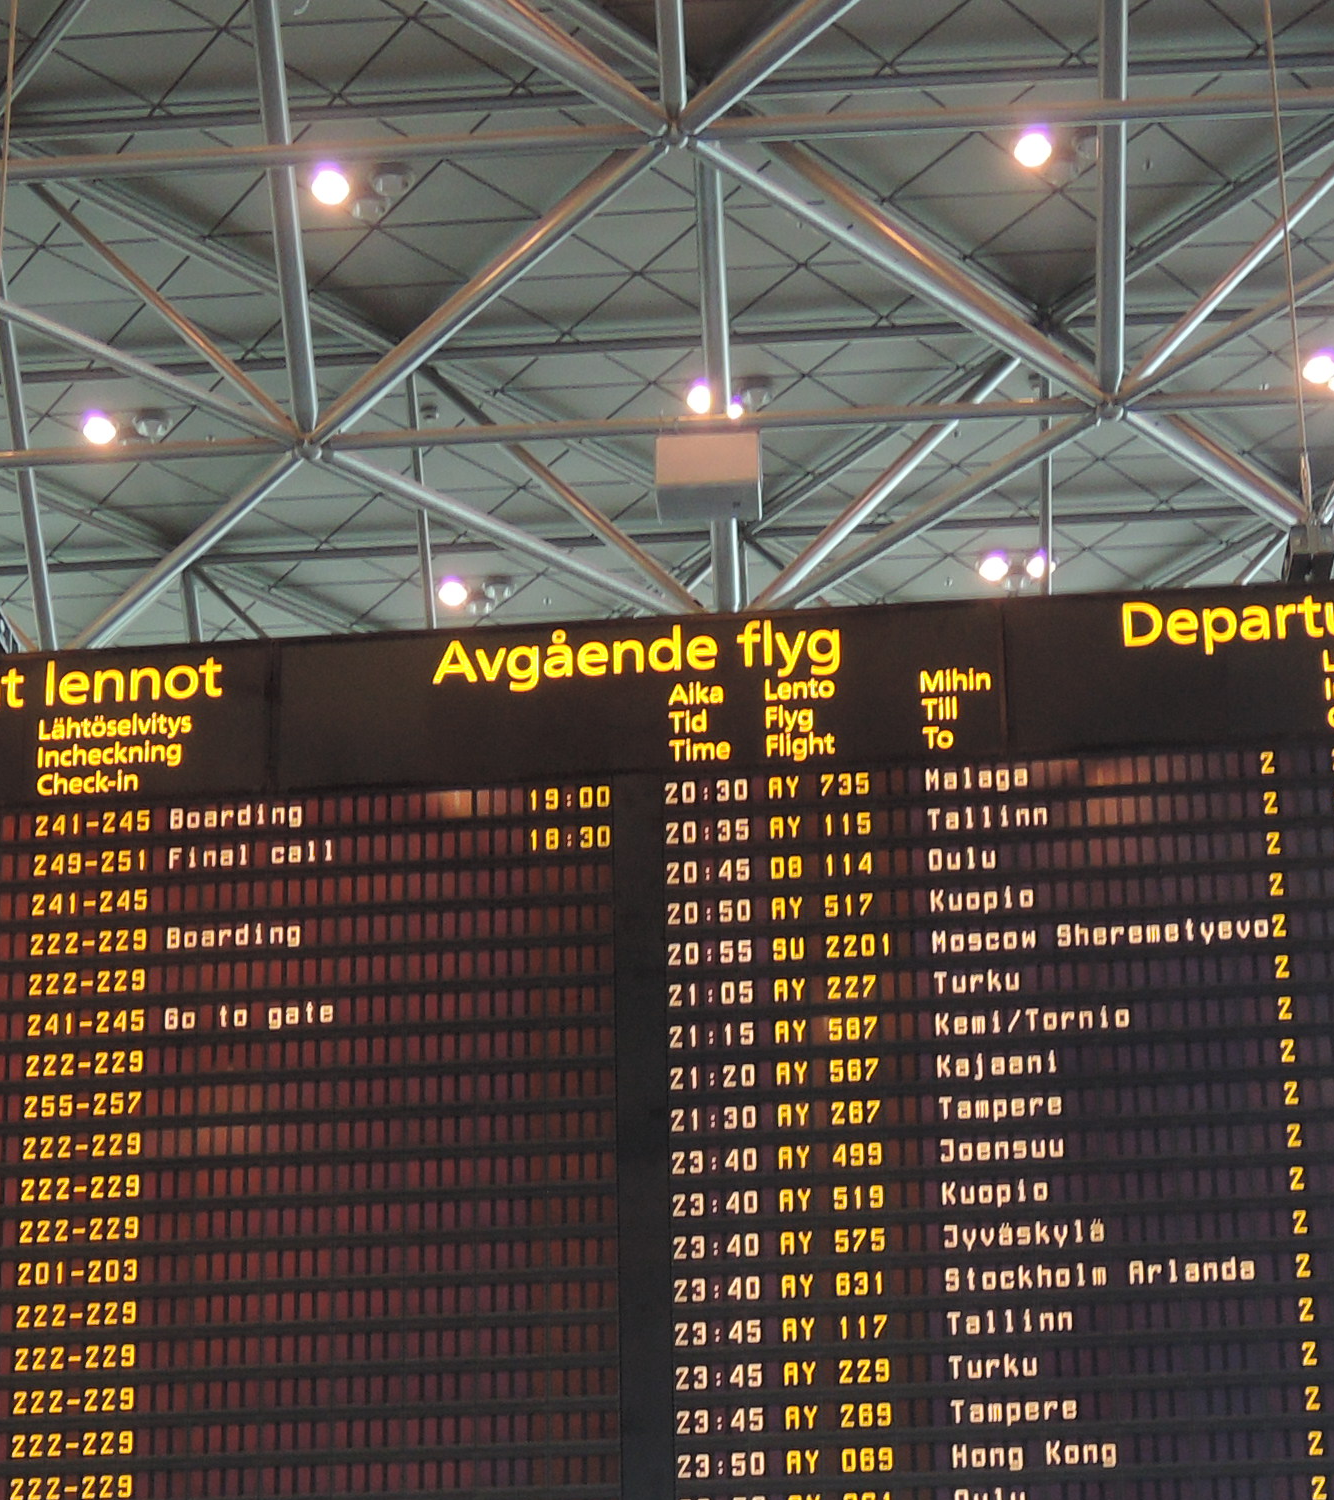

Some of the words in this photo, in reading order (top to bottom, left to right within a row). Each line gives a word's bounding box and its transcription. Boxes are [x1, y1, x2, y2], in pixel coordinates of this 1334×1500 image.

[432, 624, 719, 693] Avgående
[737, 620, 840, 677] flyg
[46, 658, 222, 705] lennot
[669, 681, 723, 705] Aika
[765, 678, 835, 700] Lento
[920, 668, 991, 692] Mihin
[669, 709, 707, 733] Tid
[766, 705, 813, 733] Flyg
[922, 696, 957, 720] Till
[39, 712, 191, 740] Lähtöselvitys
[923, 727, 953, 749] To
[38, 740, 181, 768] Incheckning
[669, 738, 730, 761] Time
[766, 732, 835, 761] Flight
[37, 770, 138, 795] Check-in
[926, 767, 1027, 791] Malaga
[170, 804, 302, 829] Boarding
[928, 805, 1047, 830] Tallinn
[169, 844, 246, 869] Final
[272, 840, 332, 863] call
[929, 847, 995, 871] Oulu
[930, 886, 1033, 913] Kuopio
[167, 923, 300, 949] Boarding
[932, 931, 1035, 953] Moscow
[1057, 919, 1268, 946] Sheremetyevo
[934, 969, 1019, 994] Turku
[165, 1008, 195, 1029] Go
[220, 1006, 247, 1027] to
[269, 1002, 333, 1029] gate
[935, 1006, 1129, 1036] Kemi/Tornio
[937, 1050, 1056, 1080] Kajaani
[939, 1097, 1061, 1122] Tampere
[940, 1139, 1063, 1162] Joensuu
[942, 1179, 1047, 1207] Kuopio
[944, 1219, 1104, 1251] Jyväskylä
[945, 1263, 1106, 1291] Stockholm
[1129, 1257, 1254, 1284] Arlanda
[947, 1309, 1072, 1335] Tallinn
[949, 1354, 1037, 1379] Turku
[951, 1400, 1076, 1426] Tampere
[953, 1444, 1023, 1471] Hong
[1046, 1441, 1116, 1467] Kong
